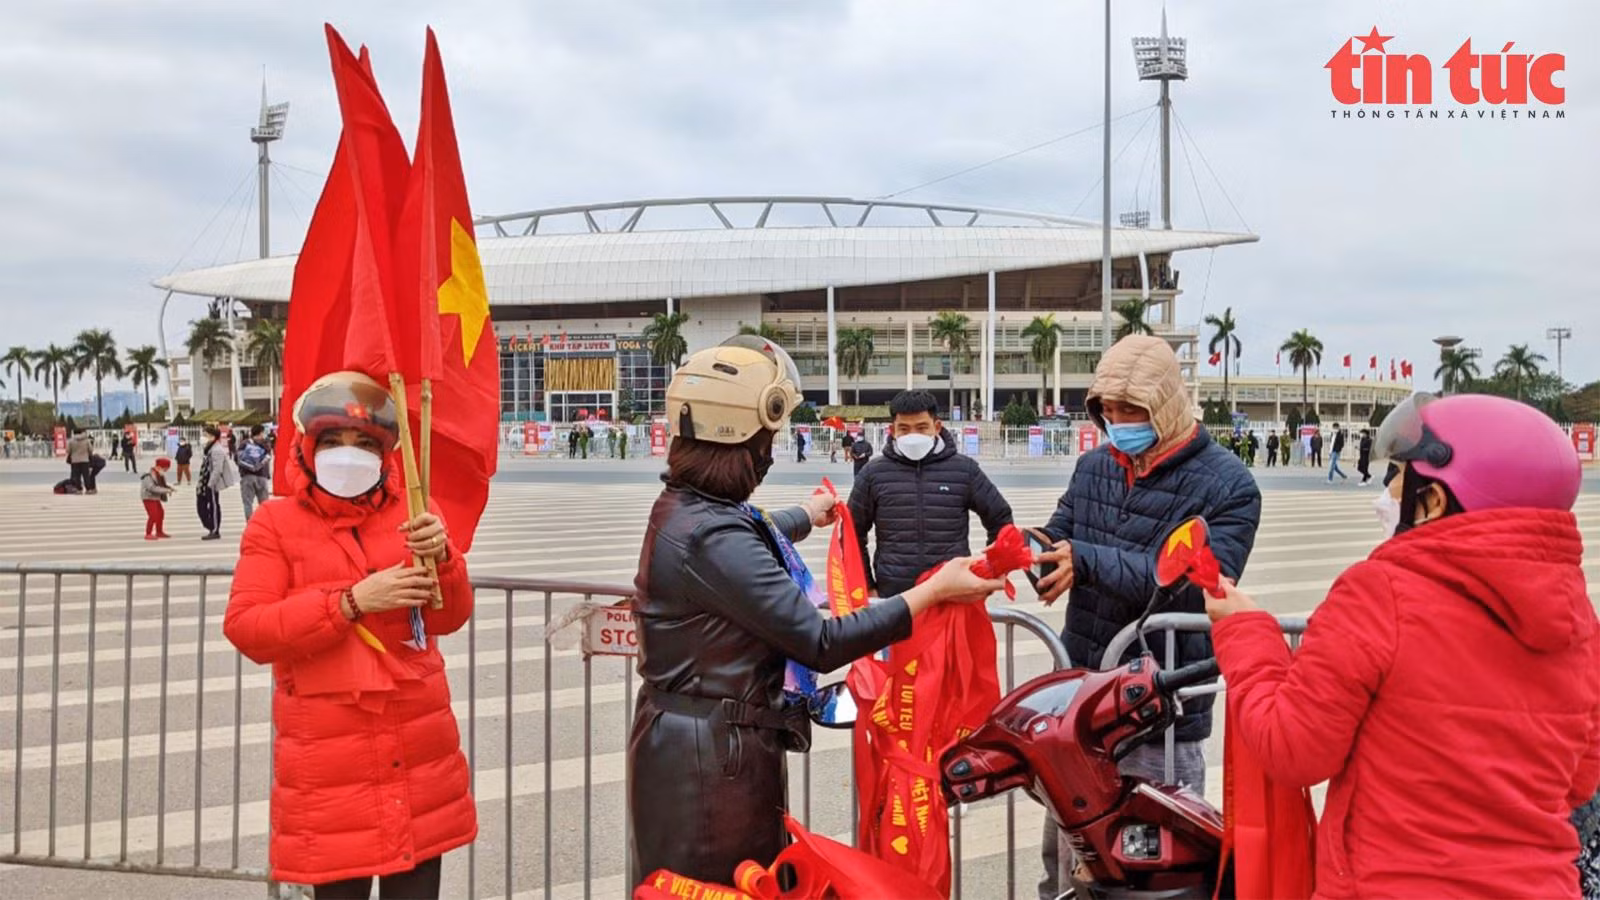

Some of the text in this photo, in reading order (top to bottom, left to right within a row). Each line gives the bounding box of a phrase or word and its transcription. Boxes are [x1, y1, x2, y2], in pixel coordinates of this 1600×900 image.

[617, 341, 641, 350] YOGA
[607, 612, 637, 622] POLI
[601, 629, 638, 646] STO
